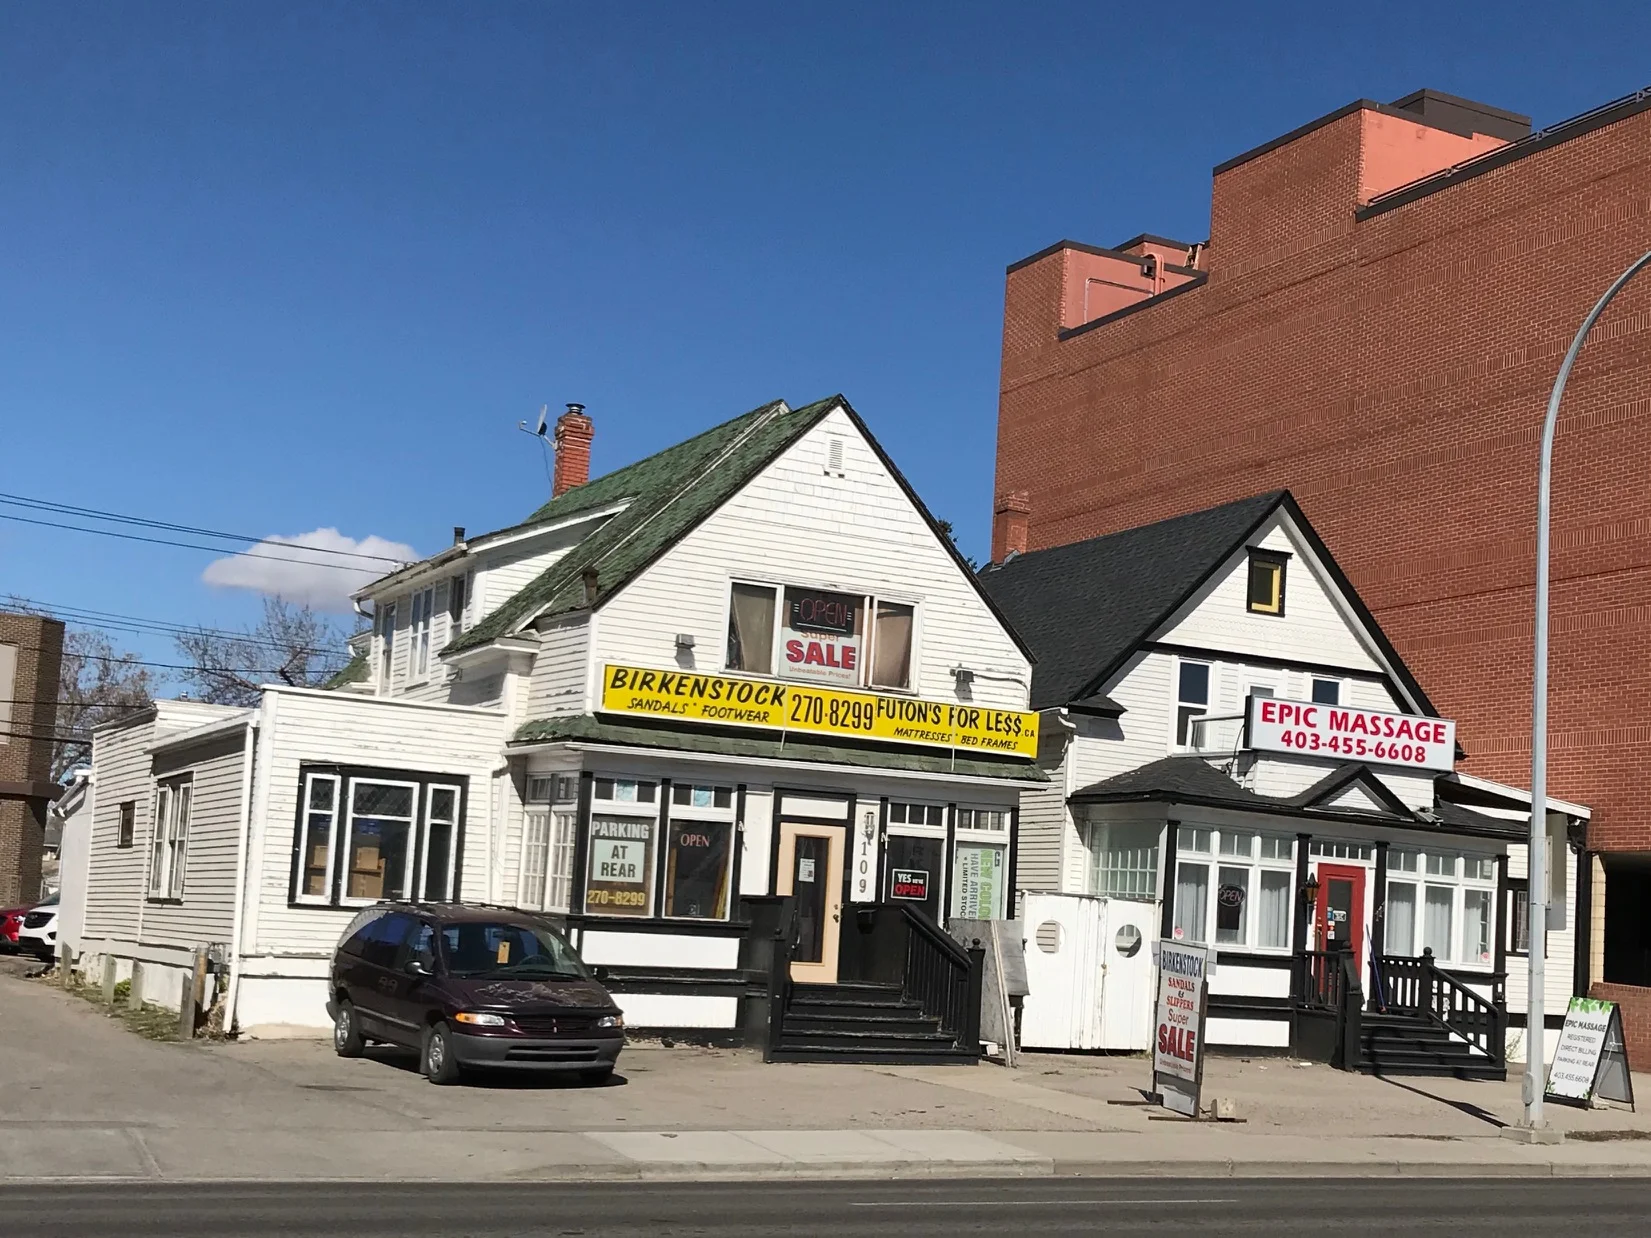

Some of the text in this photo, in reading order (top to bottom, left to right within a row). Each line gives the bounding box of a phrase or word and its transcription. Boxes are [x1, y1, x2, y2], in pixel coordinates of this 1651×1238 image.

[801, 598, 847, 626] OPEN
[786, 640, 856, 670] SALE
[610, 668, 786, 707] BIRKENSTOCK
[627, 697, 770, 723] SANDALS FOOTWEAR
[877, 698, 941, 725] FUTON'S
[1261, 702, 1447, 744] EPIC MASSAGE
[894, 727, 1019, 750] MATTRESSES BED FRAMES
[1281, 730, 1426, 763] 403-455-6608
[591, 821, 649, 839] PARKING
[680, 833, 711, 847] OPEN
[611, 845, 628, 860] AT
[601, 861, 636, 878] REAR
[970, 853, 979, 878] HAVE
[980, 850, 993, 879] NEW
[897, 873, 911, 883] YES
[587, 890, 646, 906] 270-8299
[895, 883, 925, 897] OPEN
[960, 862, 969, 919] LIMITED STOC
[1219, 889, 1242, 902] OPEN
[1162, 949, 1203, 979] BIRKENSTOCK
[1168, 976, 1195, 993] SANDALS
[1166, 995, 1194, 1011] SLIPPERS
[1168, 1008, 1189, 1026] Super
[1565, 1019, 1607, 1033] EPIC MASSAGE
[1158, 1023, 1196, 1063] SALE
[1567, 1033, 1597, 1044] REGISTERED
[1561, 1044, 1597, 1056] DIRECT BILLING
